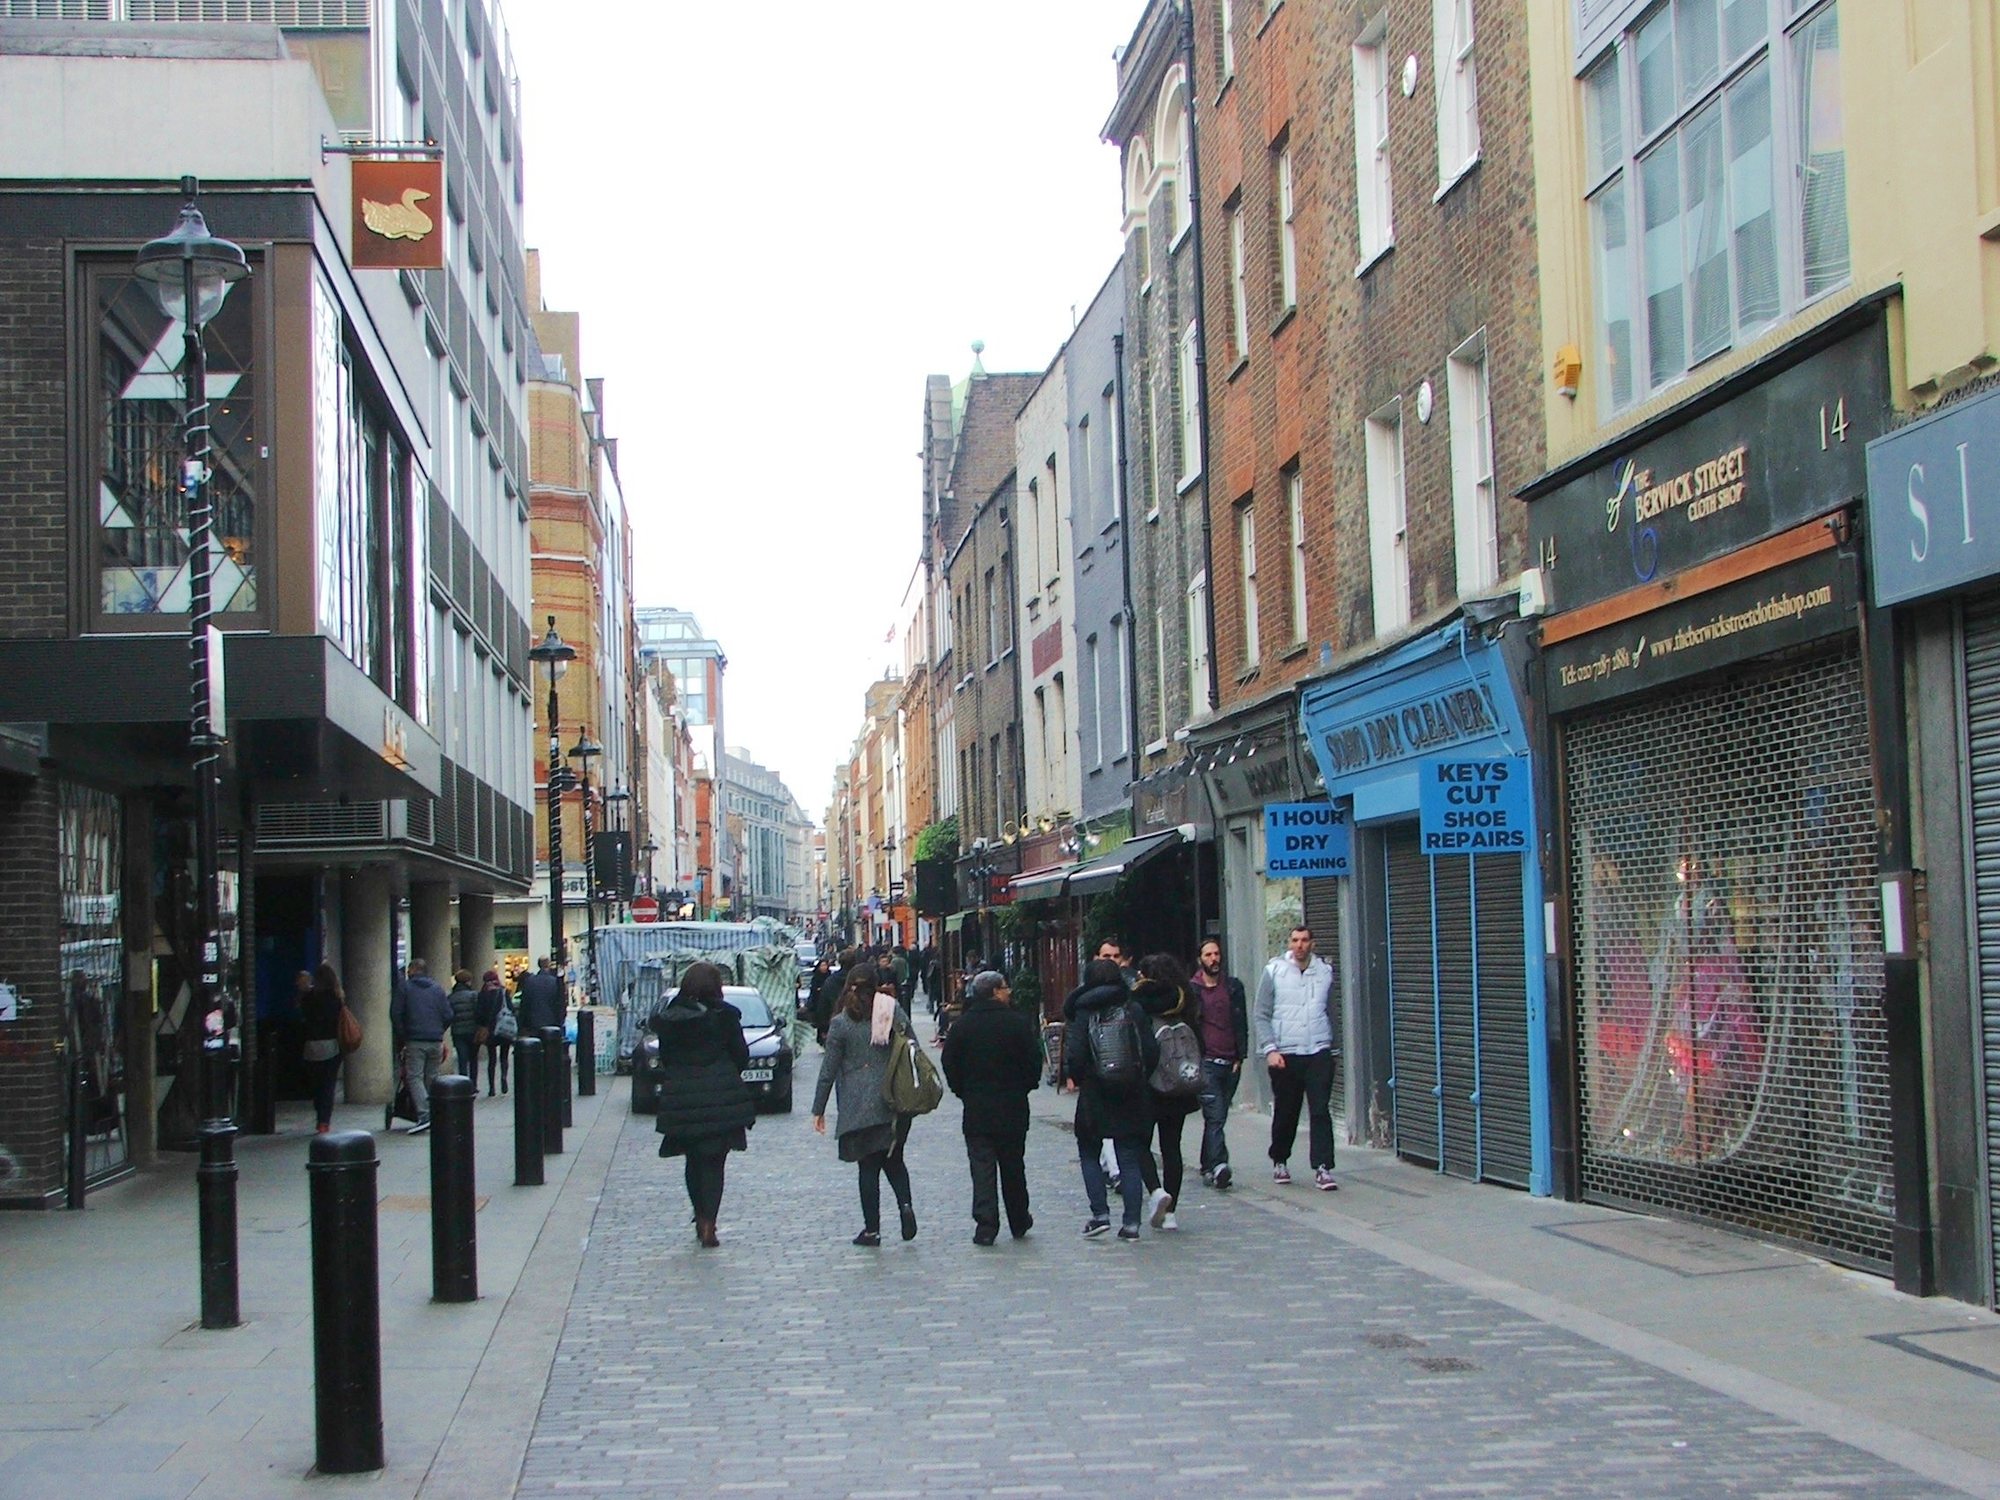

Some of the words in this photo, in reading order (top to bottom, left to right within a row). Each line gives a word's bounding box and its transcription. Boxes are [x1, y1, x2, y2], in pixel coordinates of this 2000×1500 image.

[1819, 397, 1850, 451] 14
[1633, 469, 1650, 491] THE
[1635, 472, 1693, 523] BERWICK
[1694, 447, 1746, 495] STREET
[1688, 493, 1718, 522] CLOTH
[1718, 482, 1744, 509] SHOP
[1540, 536, 1557, 574] 14
[1651, 585, 1831, 657] www.theberwickstreetclothshop.com
[1326, 726, 1370, 773] SOHO
[1365, 713, 1405, 760] DRY
[1437, 762, 1508, 782] KEYS
[1446, 785, 1501, 804] CUT
[1269, 811, 1278, 826] 1
[1283, 810, 1344, 826] HOUR
[1444, 810, 1507, 828] SHOE
[1285, 834, 1329, 851] DRY
[1426, 830, 1524, 848] REPAIRS
[1269, 857, 1347, 870] CLEANING
